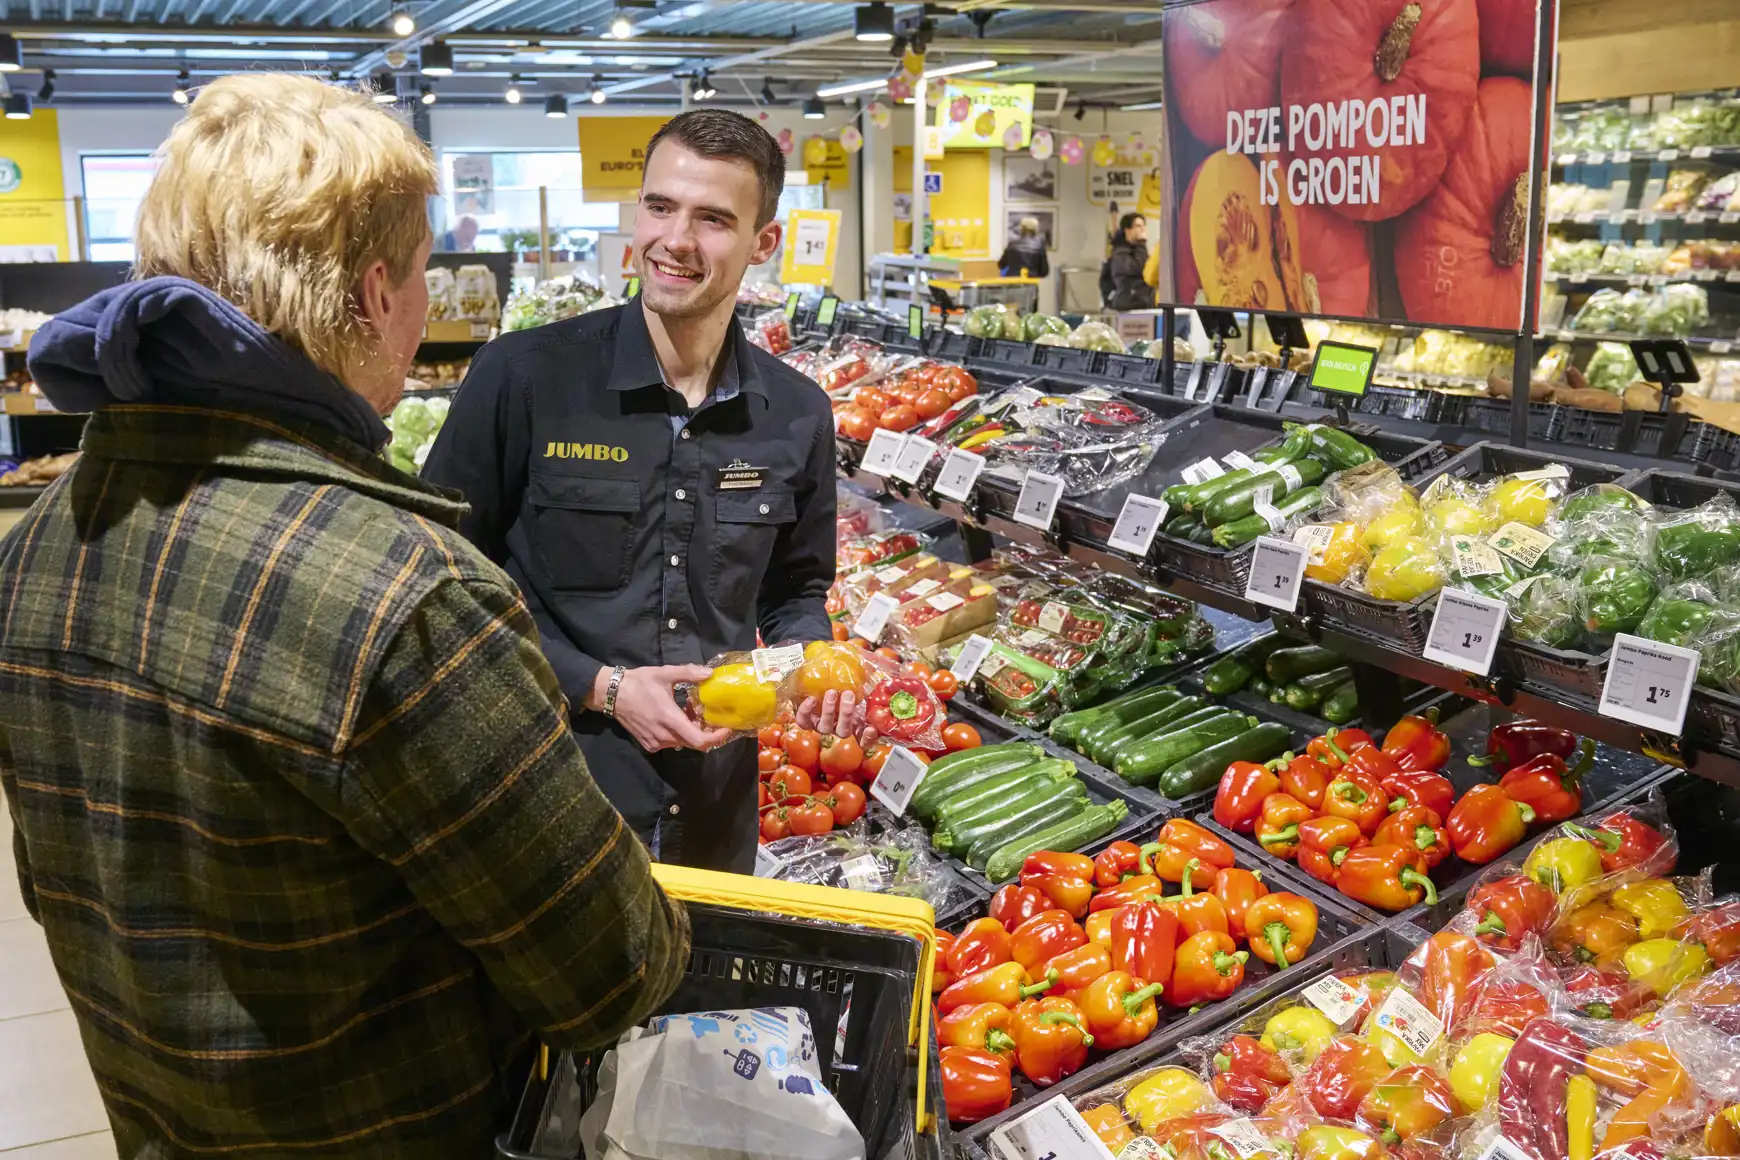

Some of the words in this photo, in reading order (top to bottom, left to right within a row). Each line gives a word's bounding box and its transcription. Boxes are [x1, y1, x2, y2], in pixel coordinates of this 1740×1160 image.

[1226, 106, 1281, 155] DEZE
[1288, 93, 1427, 151] POMPOEN
[1107, 171, 1134, 186] SNEL
[1260, 160, 1279, 205] IS
[1286, 155, 1380, 206] GROEN
[543, 442, 629, 462] JUMBO
[1459, 600, 1473, 608] Groene
[1474, 604, 1489, 612] Paprika
[1620, 644, 1638, 653] Jumbo
[1638, 648, 1657, 658] Paprika
[1658, 653, 1672, 661] Rood
[1053, 1104, 1067, 1119] Jumbo
